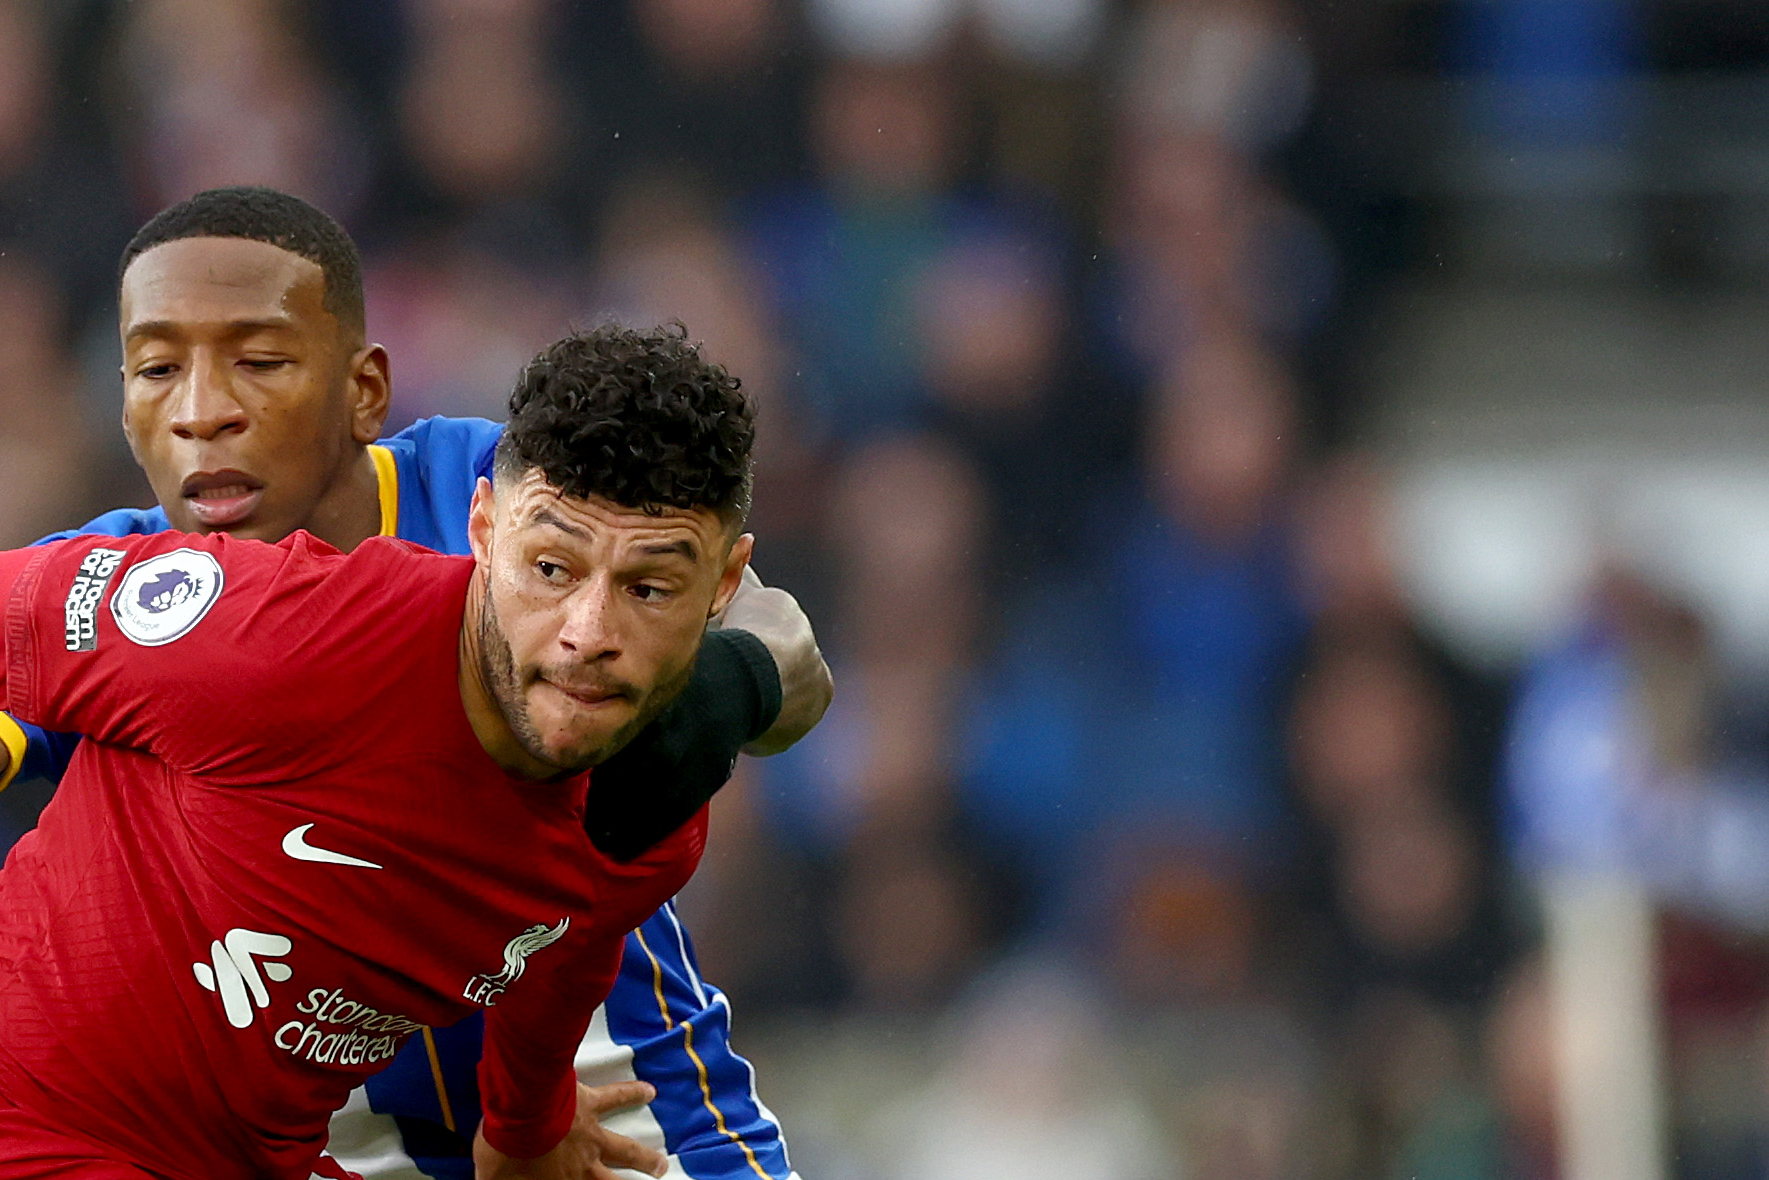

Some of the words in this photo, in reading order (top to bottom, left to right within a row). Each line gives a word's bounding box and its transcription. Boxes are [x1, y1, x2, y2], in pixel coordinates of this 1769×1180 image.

[80, 548, 102, 576] for
[96, 549, 128, 578] No
[66, 576, 91, 651] racism
[80, 579, 107, 640] room
